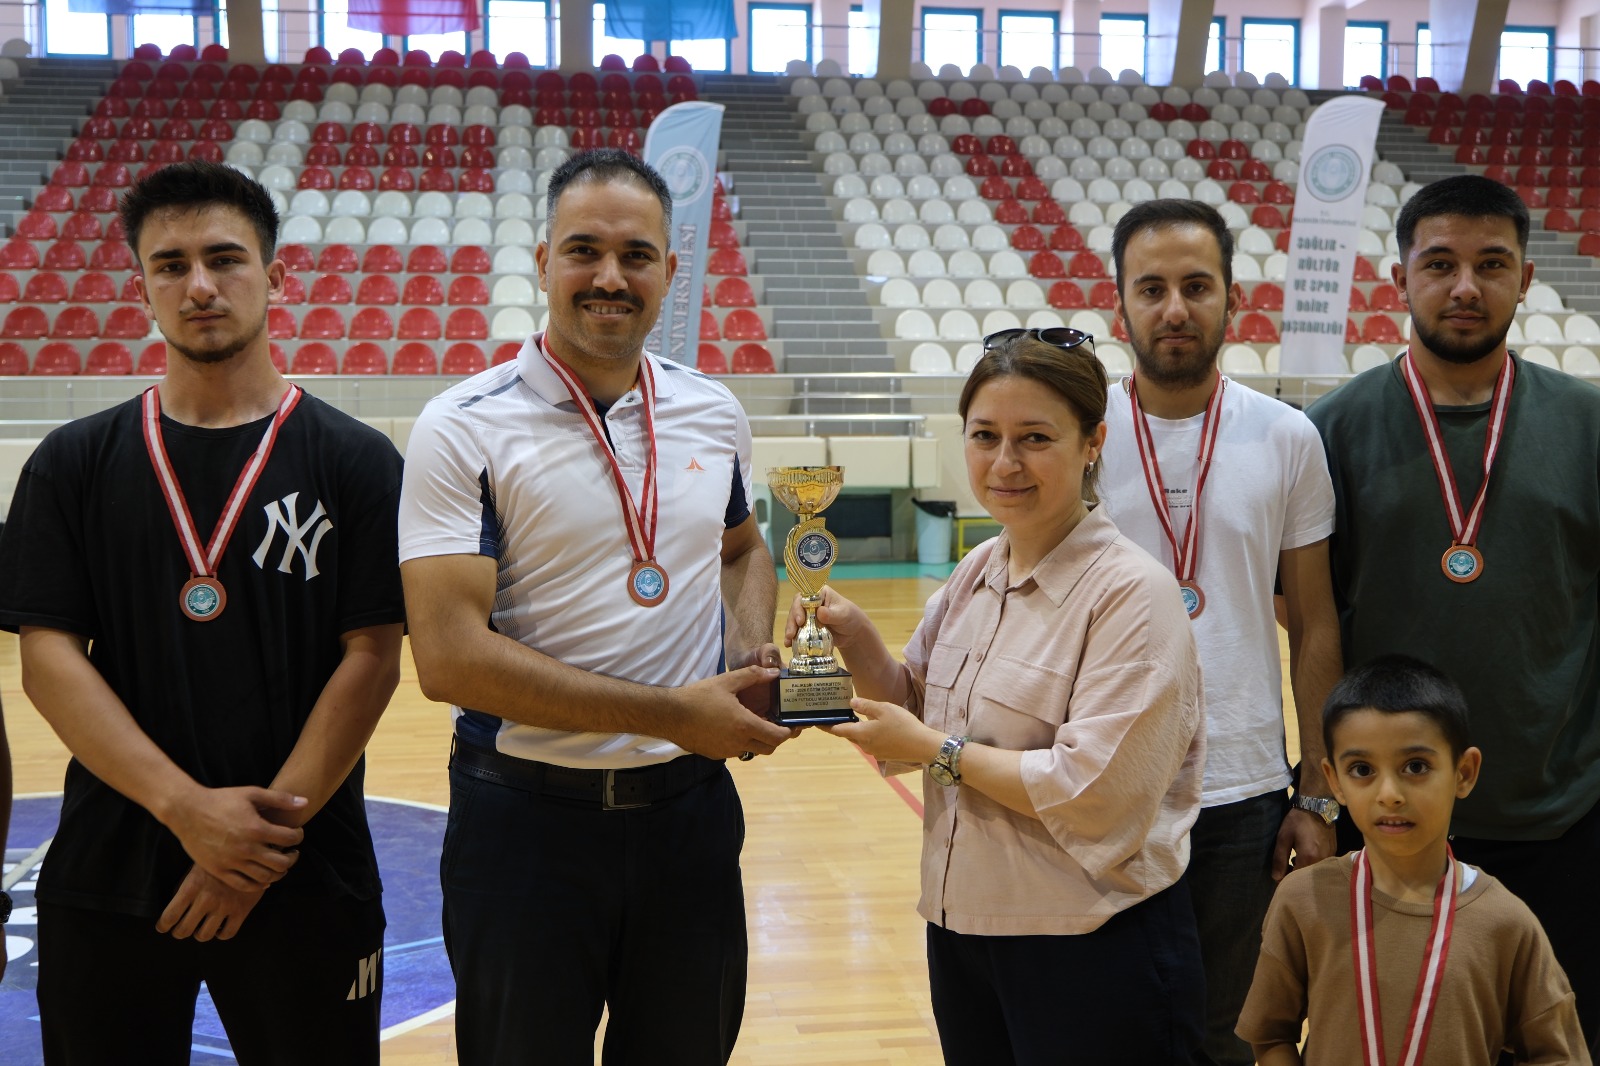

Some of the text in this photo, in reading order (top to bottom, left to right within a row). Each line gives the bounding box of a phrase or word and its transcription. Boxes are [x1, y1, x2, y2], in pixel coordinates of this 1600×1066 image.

[1297, 235, 1337, 251] SAĞLIK
[1298, 257, 1340, 273] KÜLTÜR
[1294, 279, 1339, 294] VE SPOR
[1296, 299, 1329, 315] DAİRE
[252, 491, 334, 582] NY
